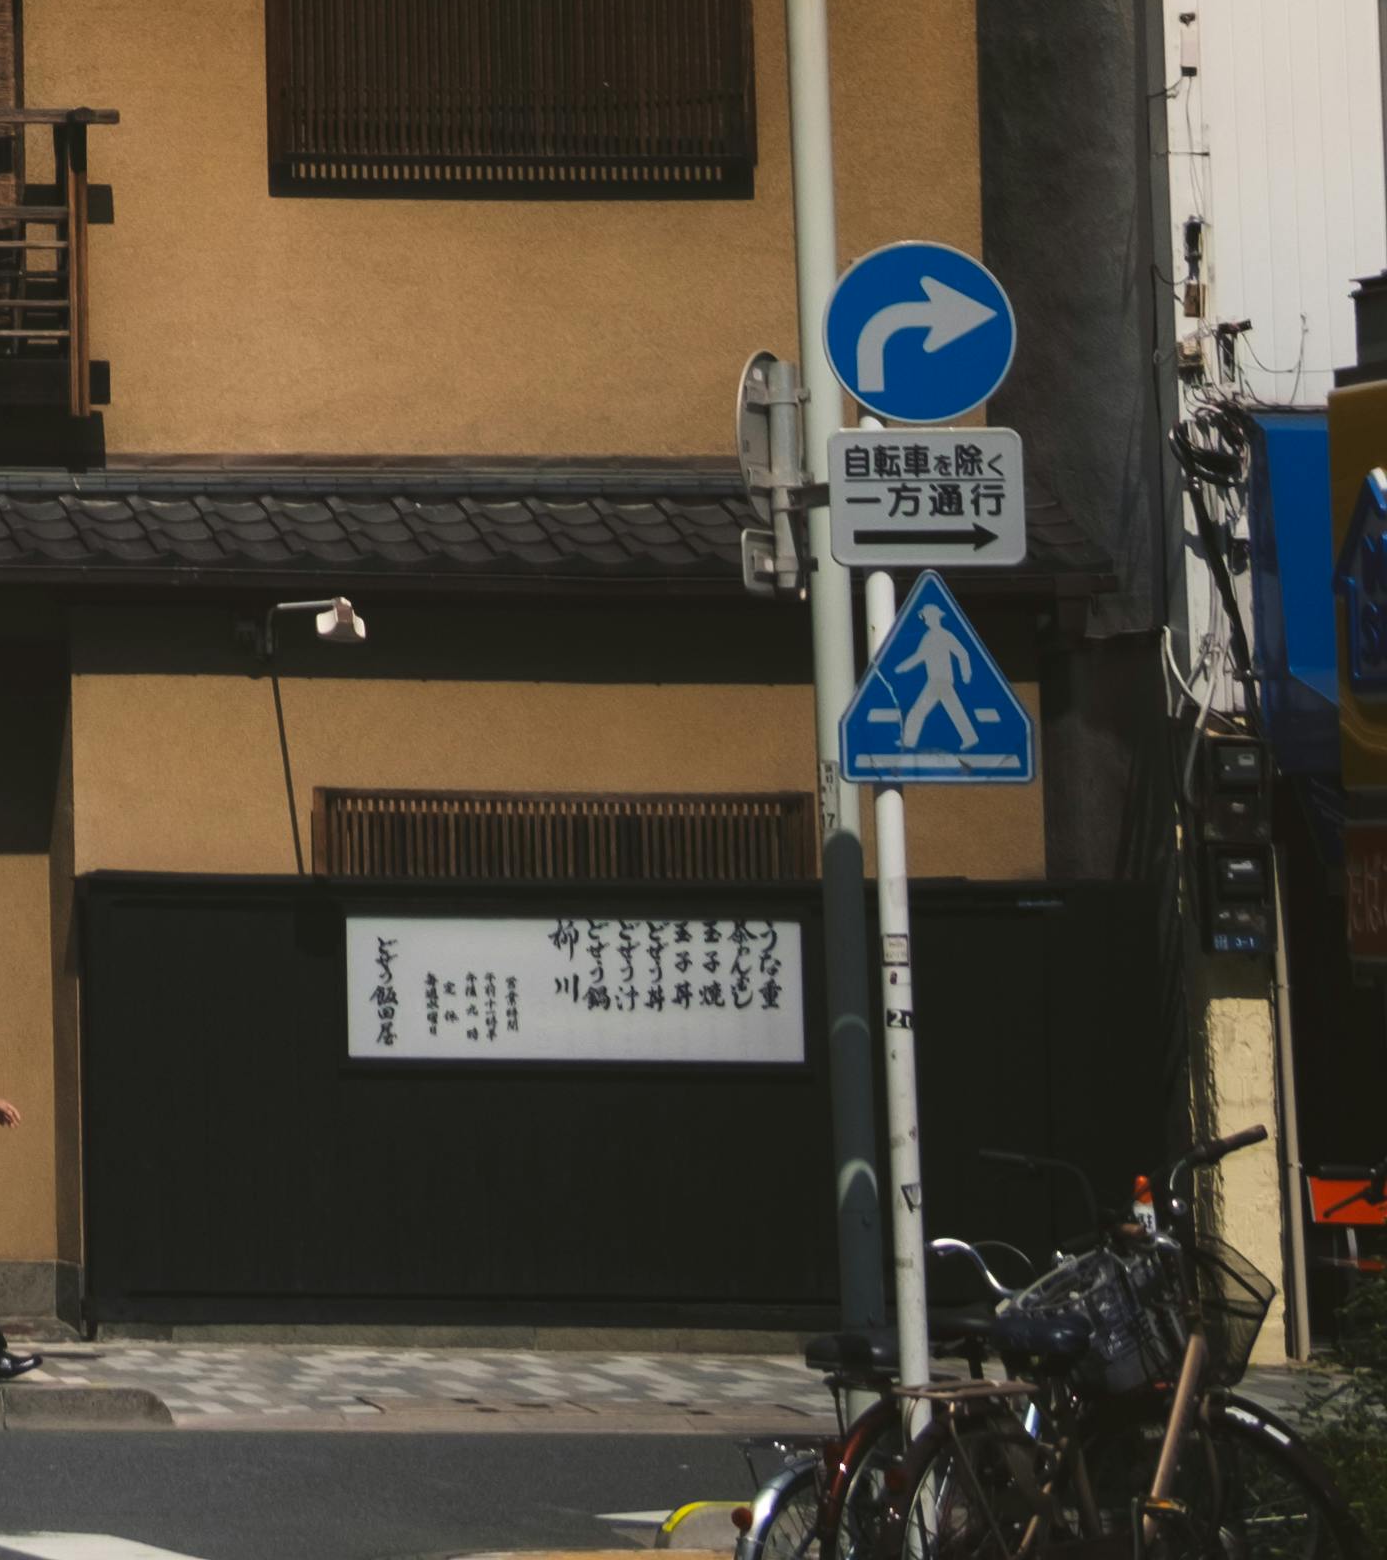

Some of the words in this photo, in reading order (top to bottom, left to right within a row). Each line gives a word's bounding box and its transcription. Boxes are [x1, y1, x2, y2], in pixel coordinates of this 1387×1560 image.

[843, 444, 1004, 479] 自転車を除く
[845, 483, 1007, 519] 一方通行
